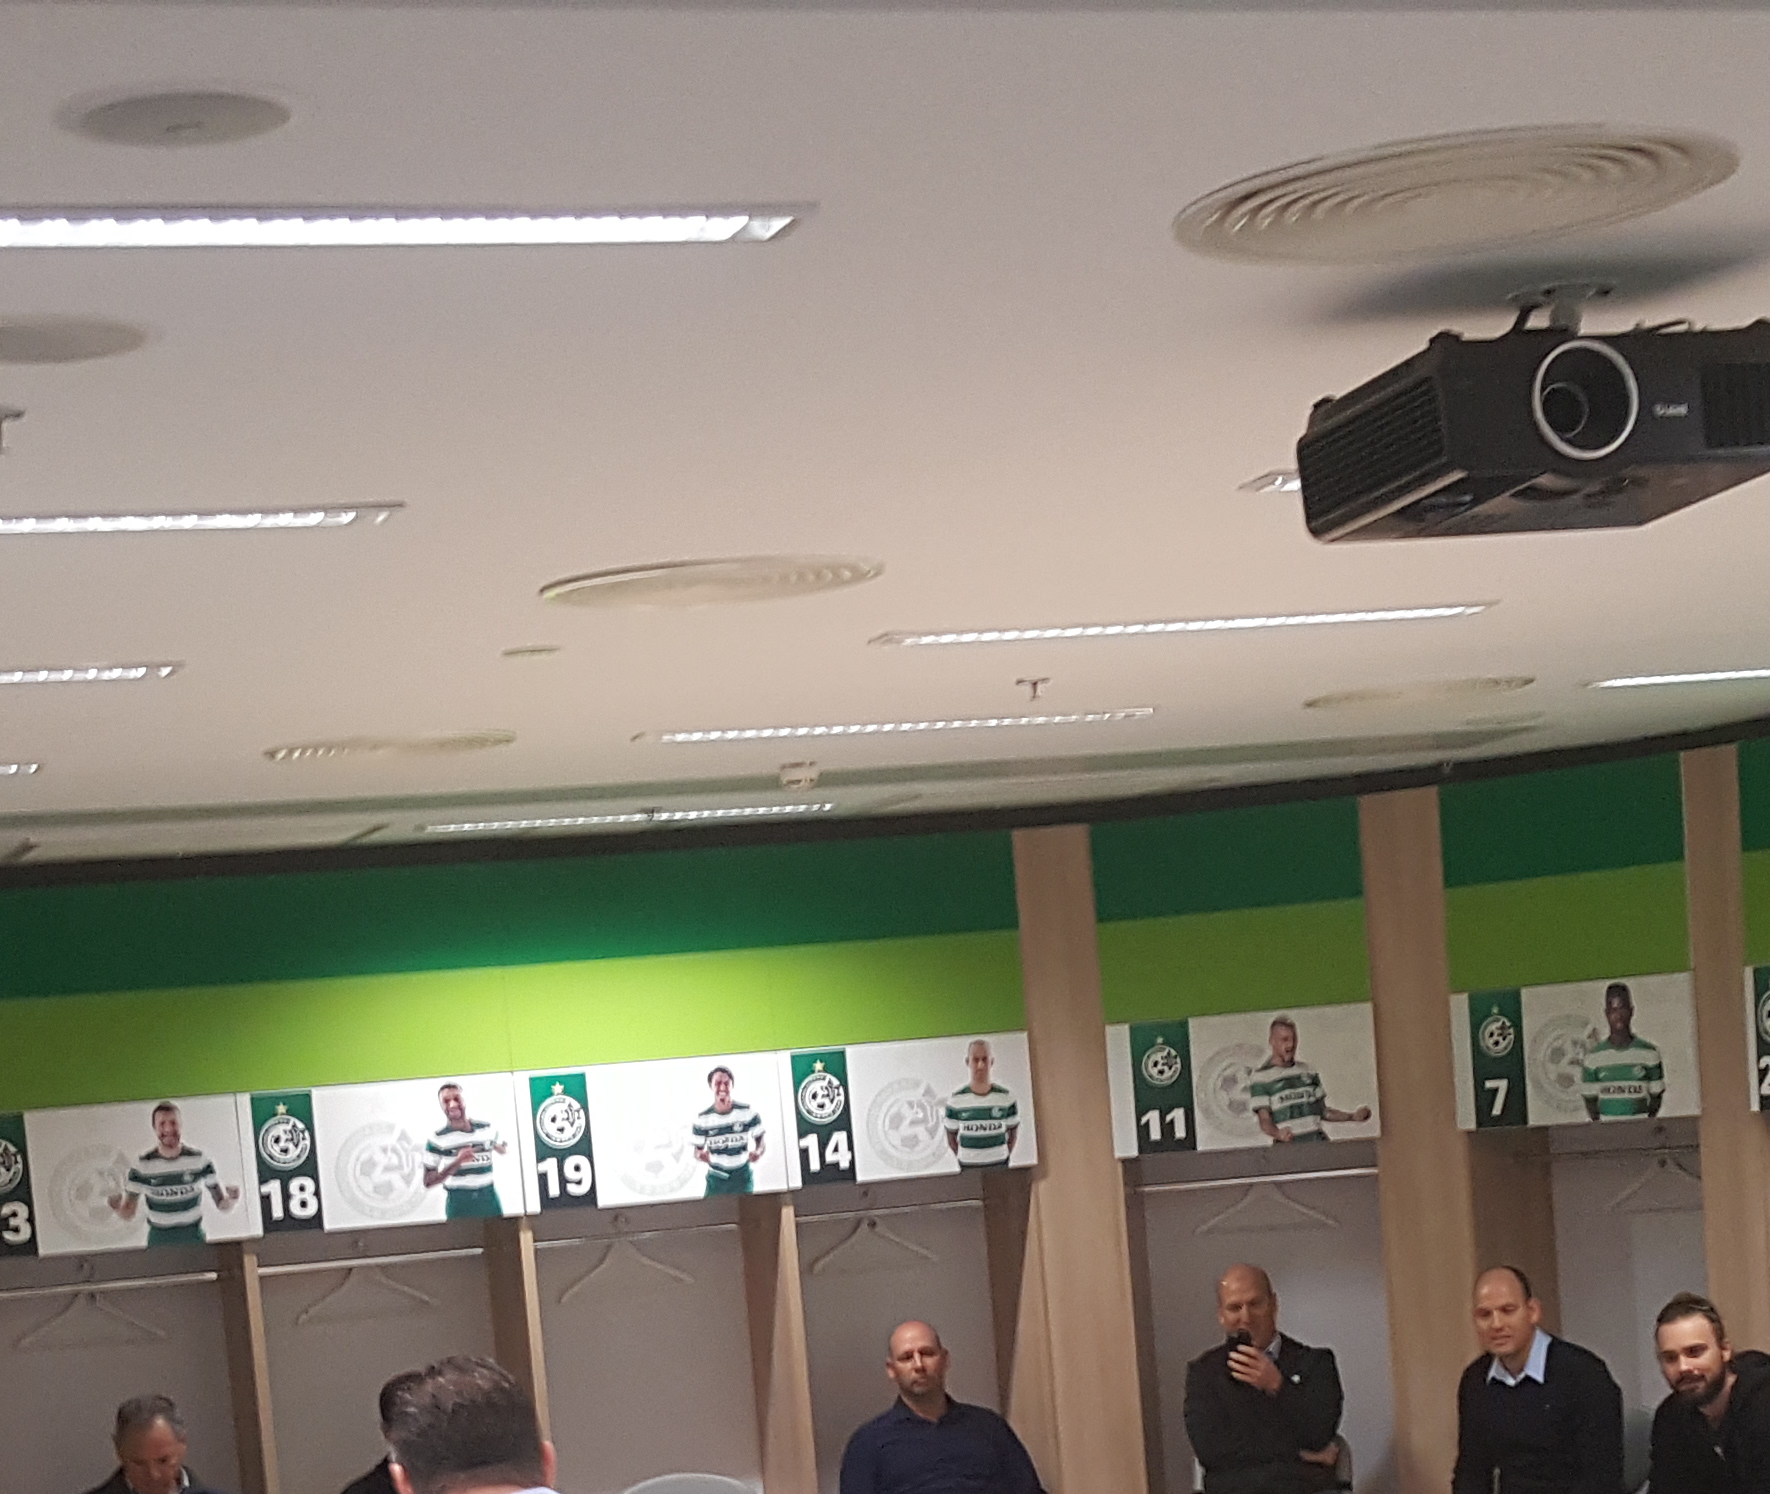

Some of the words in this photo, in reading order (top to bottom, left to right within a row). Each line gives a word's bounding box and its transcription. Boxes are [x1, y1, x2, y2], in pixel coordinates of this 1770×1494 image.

[1483, 1078, 1510, 1118] 7
[1140, 1107, 1187, 1142] 11
[798, 1130, 853, 1174] 14
[537, 1154, 593, 1198] 19
[259, 1175, 320, 1222] 18
